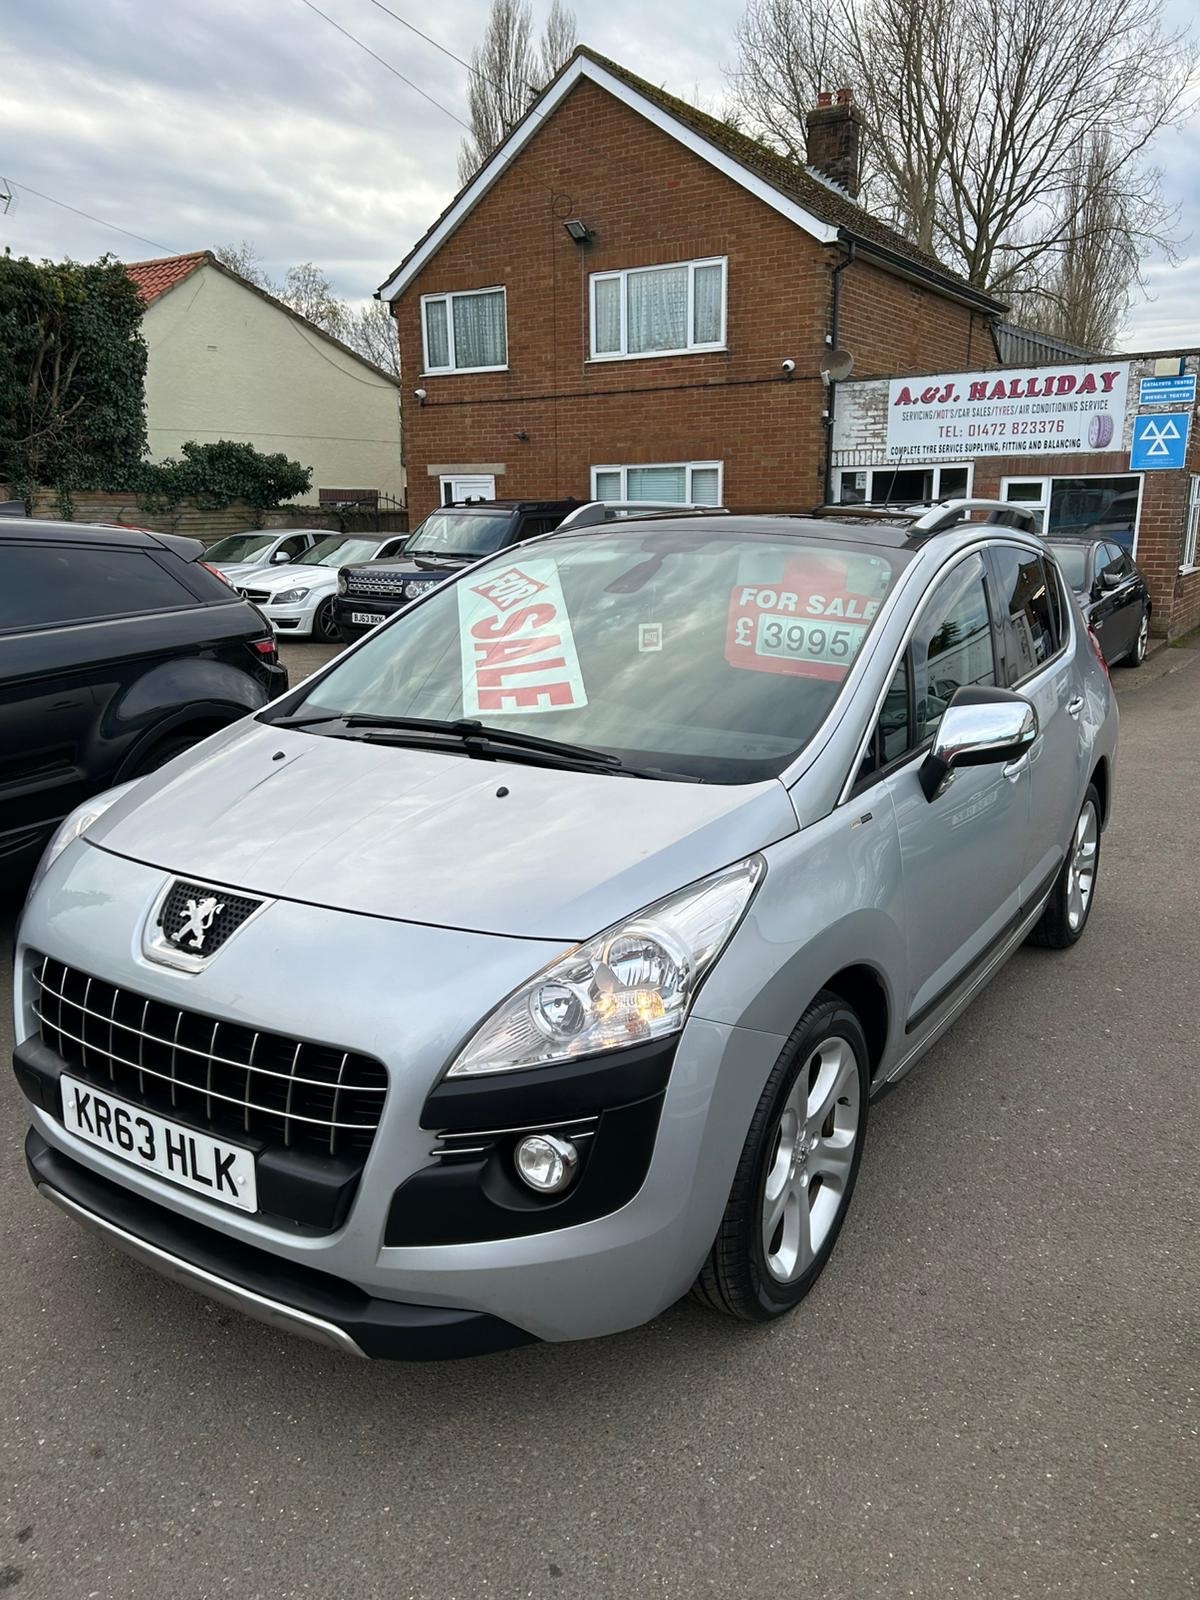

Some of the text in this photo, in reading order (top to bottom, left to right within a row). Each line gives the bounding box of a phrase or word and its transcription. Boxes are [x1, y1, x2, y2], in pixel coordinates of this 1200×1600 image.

[968, 371, 1120, 401] HALLIDAY
[1031, 402, 1078, 414] CONDITIONING
[1080, 400, 1108, 411] SERVICE
[939, 420, 1064, 438] TEL: 01472 823376
[891, 438, 1081, 456] COMPLETE TYRE SERVICE SUPPLYING, FITTING AND BALANCING
[739, 588, 881, 620] FOR SALE
[470, 571, 575, 710] FOR SALE
[764, 622, 850, 657] 3995
[74, 1087, 239, 1198] KR63 HLK
